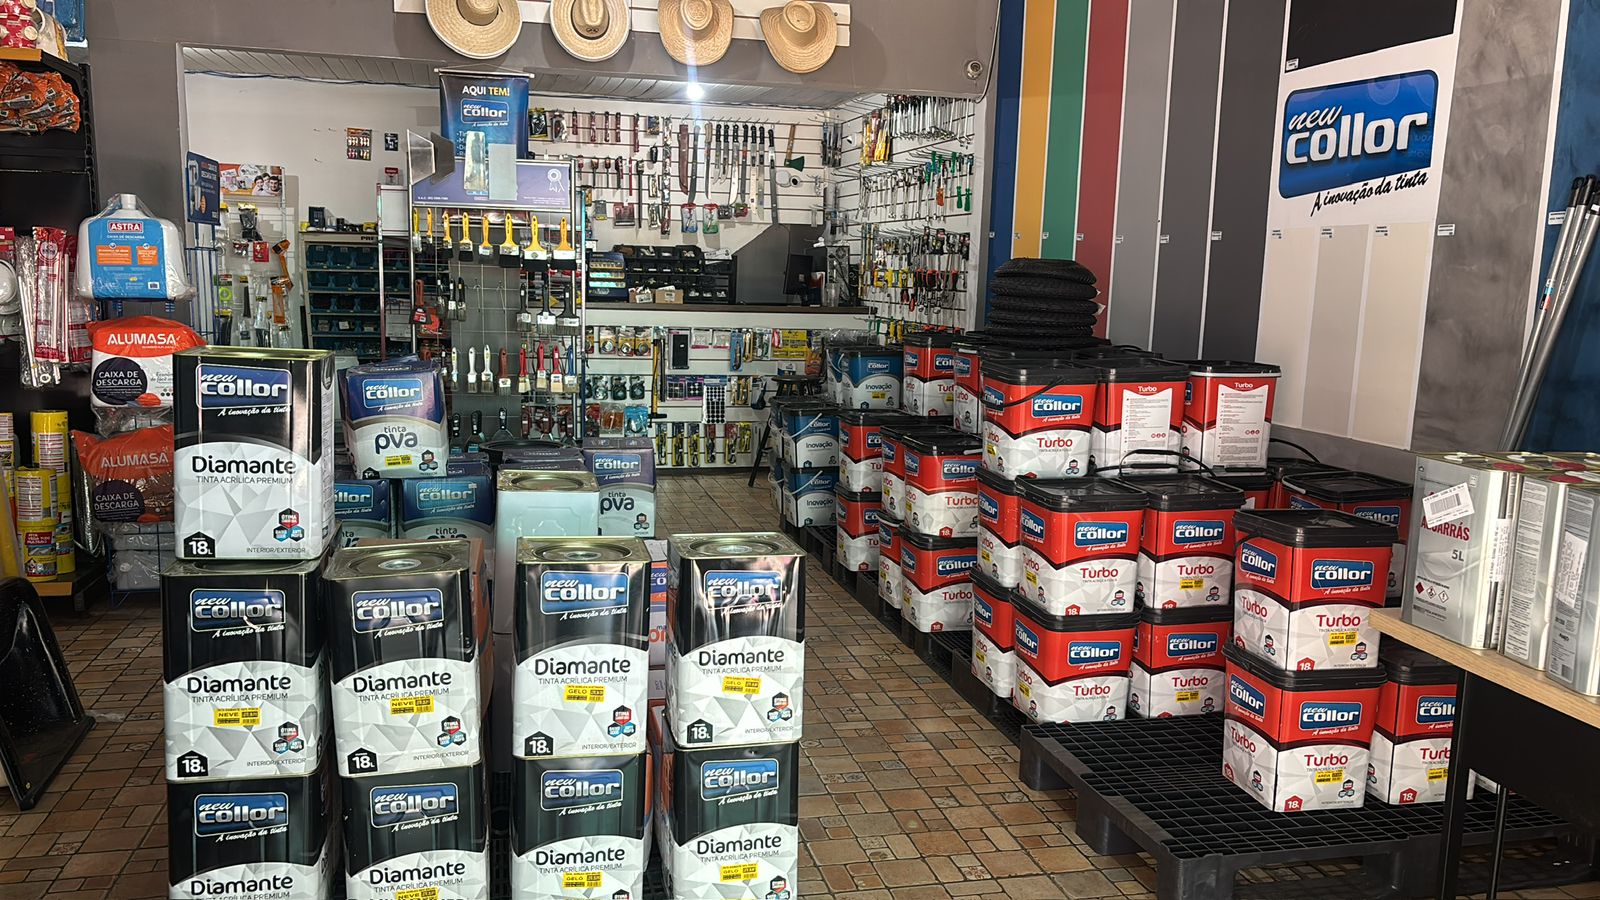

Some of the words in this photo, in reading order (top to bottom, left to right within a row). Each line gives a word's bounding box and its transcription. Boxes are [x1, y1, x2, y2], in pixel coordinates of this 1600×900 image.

[462, 85, 486, 96] AQUI
[488, 86, 510, 96] TEM!
[464, 107, 506, 117] collor
[1289, 105, 1342, 131] new
[1286, 112, 1428, 164] collor
[1310, 193, 1322, 217] A
[1323, 183, 1373, 205] inovação
[1375, 177, 1392, 195] da
[1394, 170, 1429, 192] tinta
[111, 223, 140, 231] ASTRA
[108, 334, 176, 345] ALUMASA
[868, 362, 889, 371] collor
[201, 374, 238, 384] new
[200, 379, 288, 398] collor
[366, 387, 420, 399] collor
[865, 382, 892, 391] Inovação
[1138, 385, 1157, 393] Turbo
[1033, 401, 1081, 414] collor
[1034, 397, 1054, 405] new
[217, 408, 227, 417] A
[228, 407, 261, 416] inovação
[262, 407, 271, 415] da
[384, 425, 407, 433] tinta
[374, 431, 418, 454] pva
[805, 440, 833, 449] Inovação
[1036, 436, 1073, 449] Turbo
[101, 452, 169, 469] ALUMASA
[191, 455, 297, 475] Diamante
[595, 460, 638, 470] collor
[944, 466, 976, 474] collo
[196, 476, 217, 484] TINTA
[218, 475, 255, 485] ACRÍLICA
[256, 477, 293, 485] PREMIUM
[96, 493, 122, 502] CAIXA
[124, 492, 135, 500] DE
[419, 489, 472, 501] collor
[94, 500, 140, 510] DESCARGA
[600, 497, 635, 515] pva
[806, 498, 833, 508] Inovação
[435, 527, 458, 535] tinta
[1077, 523, 1099, 532] new
[1175, 523, 1195, 531] new
[1175, 526, 1222, 541] collor
[1077, 527, 1126, 544] collor
[188, 541, 213, 555] 18L
[1241, 551, 1276, 572] collor
[1451, 549, 1464, 562] 5L
[938, 560, 976, 571] collor
[1177, 564, 1214, 578] Turbo
[1314, 564, 1339, 572] new
[1080, 567, 1118, 580] Turbo
[1313, 567, 1371, 584] collor
[545, 578, 578, 588] new
[708, 577, 739, 586] new
[544, 581, 625, 601] collor
[707, 581, 778, 598] collor
[942, 591, 972, 601] Turbo
[195, 597, 232, 606] new
[356, 597, 391, 607] new
[1241, 596, 1268, 619] Turbo
[194, 600, 281, 620] collor
[355, 600, 439, 620] collor
[560, 612, 569, 621] A
[570, 611, 599, 620] inovação
[599, 610, 609, 618] da
[1316, 613, 1361, 629] Turbo
[1169, 636, 1190, 644] new
[1169, 639, 1217, 652] collor
[1070, 643, 1089, 651] new
[1070, 646, 1120, 660] collor
[698, 649, 784, 668] Diamante
[534, 657, 631, 676] Diamante
[721, 665, 751, 674] ACRÍLICA
[751, 665, 782, 673] PREMIUM
[187, 674, 291, 694] Diamante
[353, 670, 452, 694] Diamante
[538, 677, 559, 685] TINTA
[560, 676, 593, 685] ACRÍLICA
[594, 675, 628, 683] PREMIUM
[1172, 675, 1209, 688] Turbo
[358, 693, 381, 702] TINTA
[414, 688, 449, 697] PREMIUM
[1073, 684, 1111, 697] Turbo
[1230, 683, 1265, 710] collor
[191, 695, 214, 704] TINTA
[214, 693, 250, 703] ACRÍLICA
[251, 692, 288, 701] PREMIUM
[1302, 708, 1359, 723] collor
[1303, 706, 1328, 715] new
[1419, 703, 1456, 716] coll
[691, 727, 711, 740] 18L
[744, 725, 795, 734] INTERIOR/EXTERIOR
[1230, 724, 1256, 754] Turbo
[529, 739, 550, 754] 18L
[581, 742, 637, 751] INTERIOR/EXTERIOR
[413, 750, 469, 761] INTERIOR/EXTERIOR
[1419, 747, 1452, 760] Turb
[181, 759, 206, 773] 18L
[246, 758, 306, 767] INTERIOR/EXTERIOR
[352, 755, 375, 770] 18L
[1303, 752, 1349, 769] Turbo
[705, 767, 735, 777] new
[545, 778, 577, 786] new
[704, 770, 776, 788] collor
[544, 781, 620, 799] collor
[375, 792, 408, 802] new
[198, 801, 235, 810] new
[374, 795, 454, 815] collor
[198, 804, 284, 824] collor
[697, 834, 782, 856] Diamante
[535, 847, 625, 866] Diamante
[369, 861, 466, 886] Diamante
[190, 874, 294, 896] Diamante
